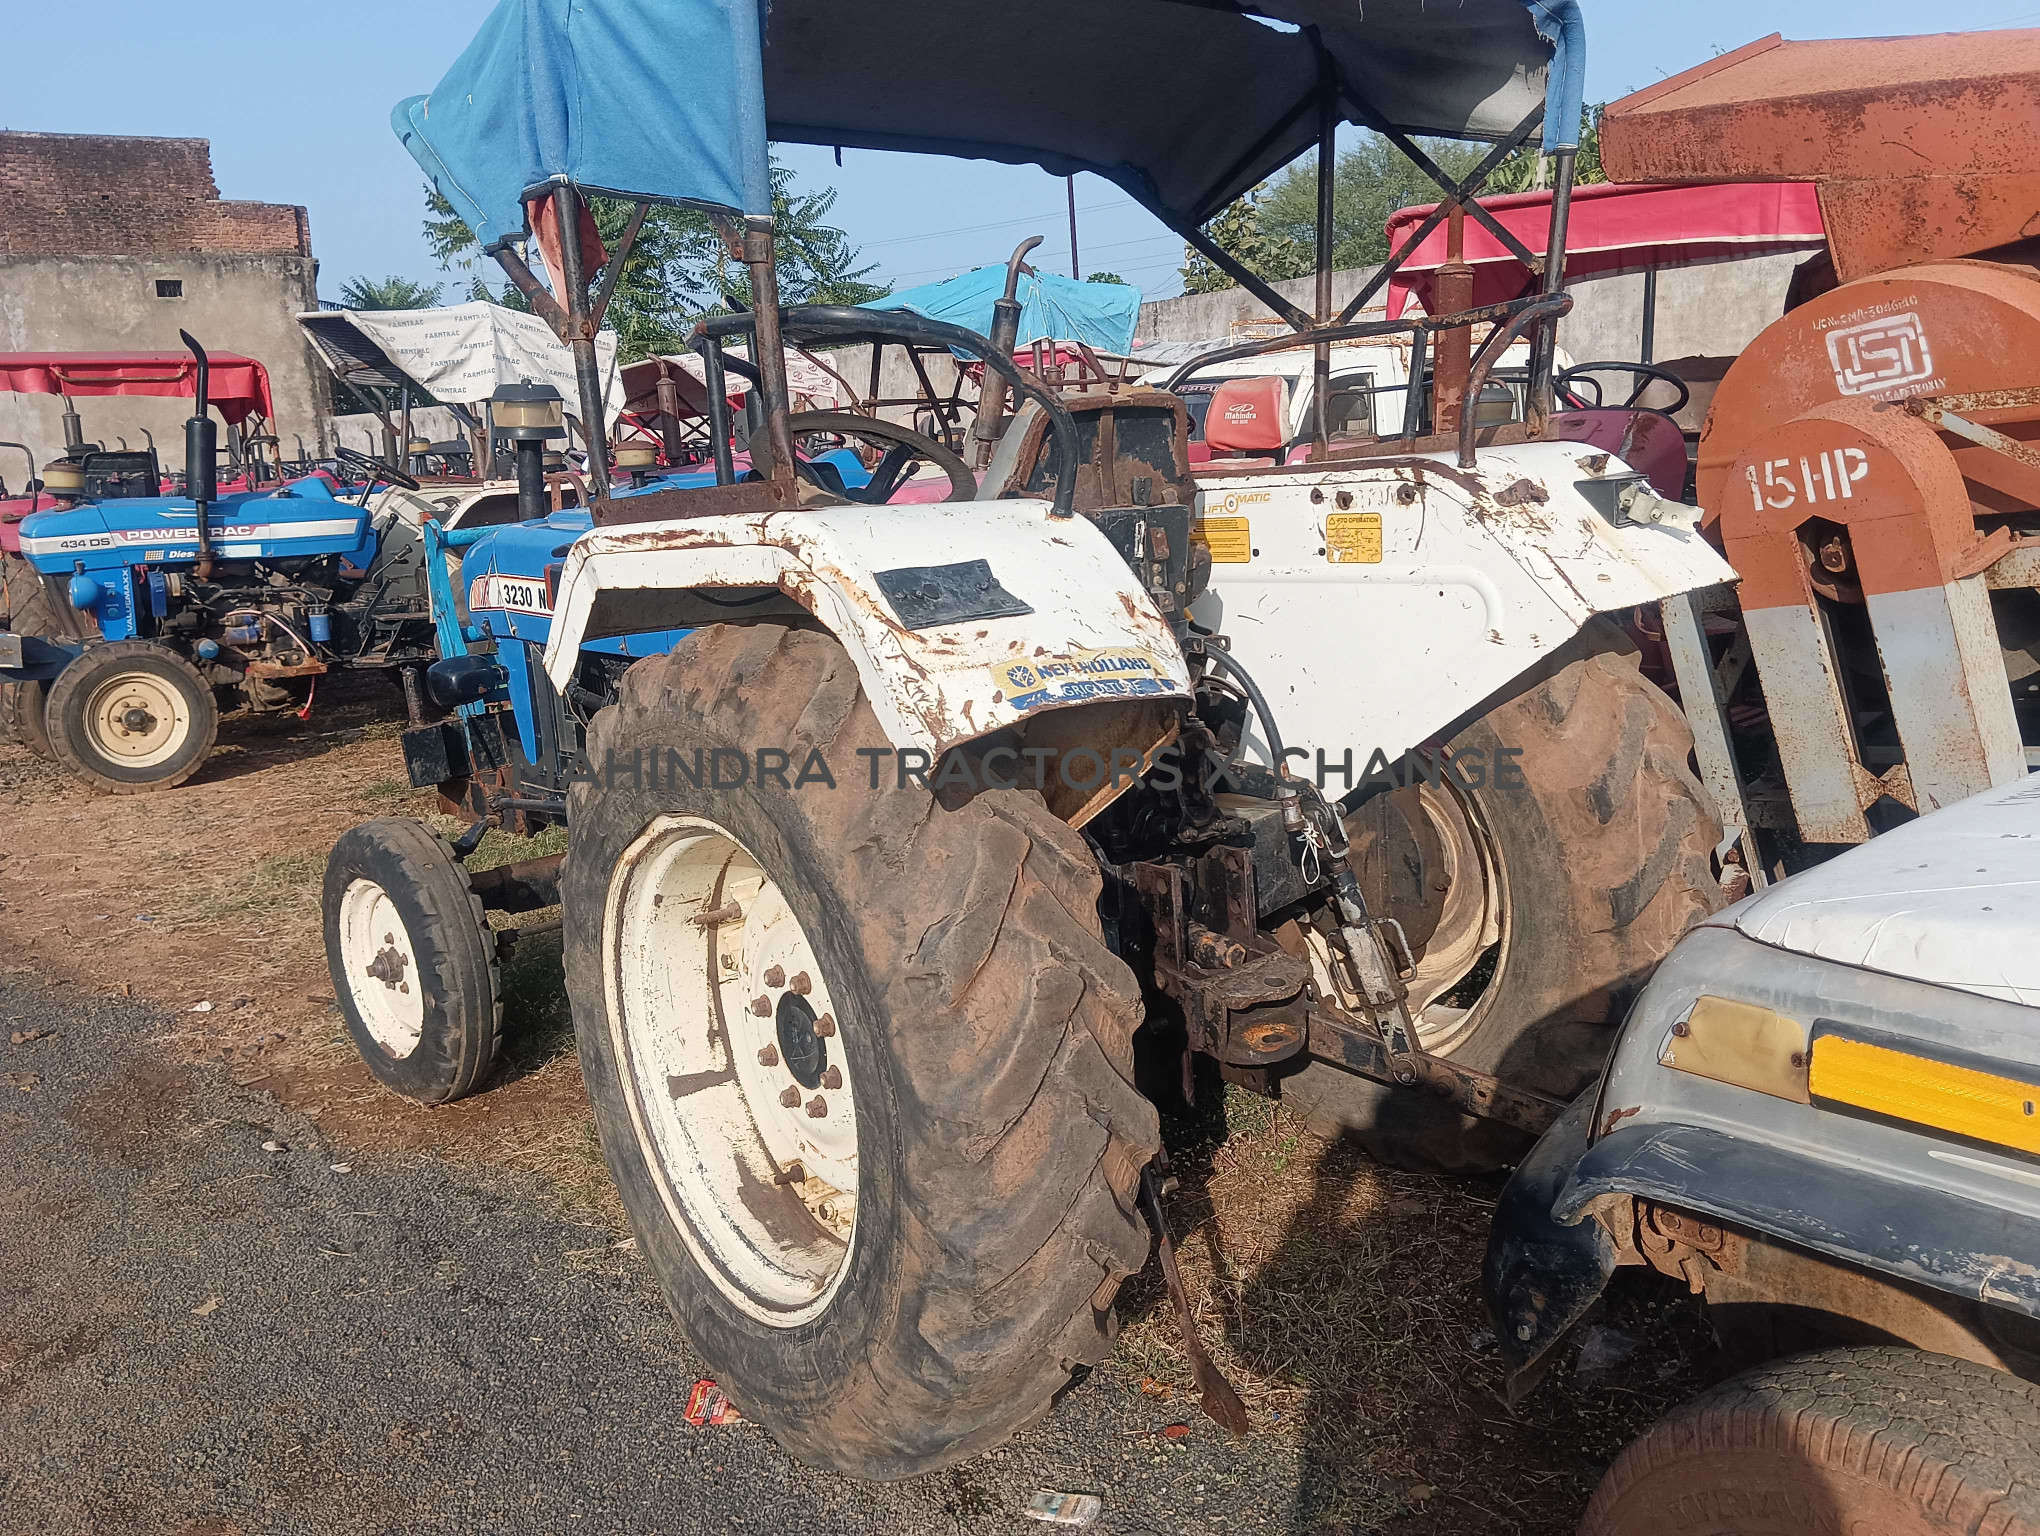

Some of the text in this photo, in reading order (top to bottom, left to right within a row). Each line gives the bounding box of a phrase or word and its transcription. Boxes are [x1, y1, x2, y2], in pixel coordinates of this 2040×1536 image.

[454, 312, 490, 322] FARMTRAC
[388, 319, 424, 328] FARMTRAC
[425, 330, 460, 339] FARMTRAC
[460, 339, 493, 350] FARMTRAC
[396, 347, 430, 355] FARMTRAC
[430, 358, 465, 367] FARMTRAC
[463, 367, 496, 379] FARMTRAC
[545, 368, 577, 381] FARMTRAC
[1224, 412, 1257, 420] Mahindra
[126, 526, 252, 541] POWERRAC
[60, 537, 111, 549] 434 DS
[122, 568, 134, 632] VALUEMAXX
[503, 584, 533, 608] 3230
[1078, 657, 1152, 674] HOLLAND
[1061, 679, 1142, 698] GRICULTURE
